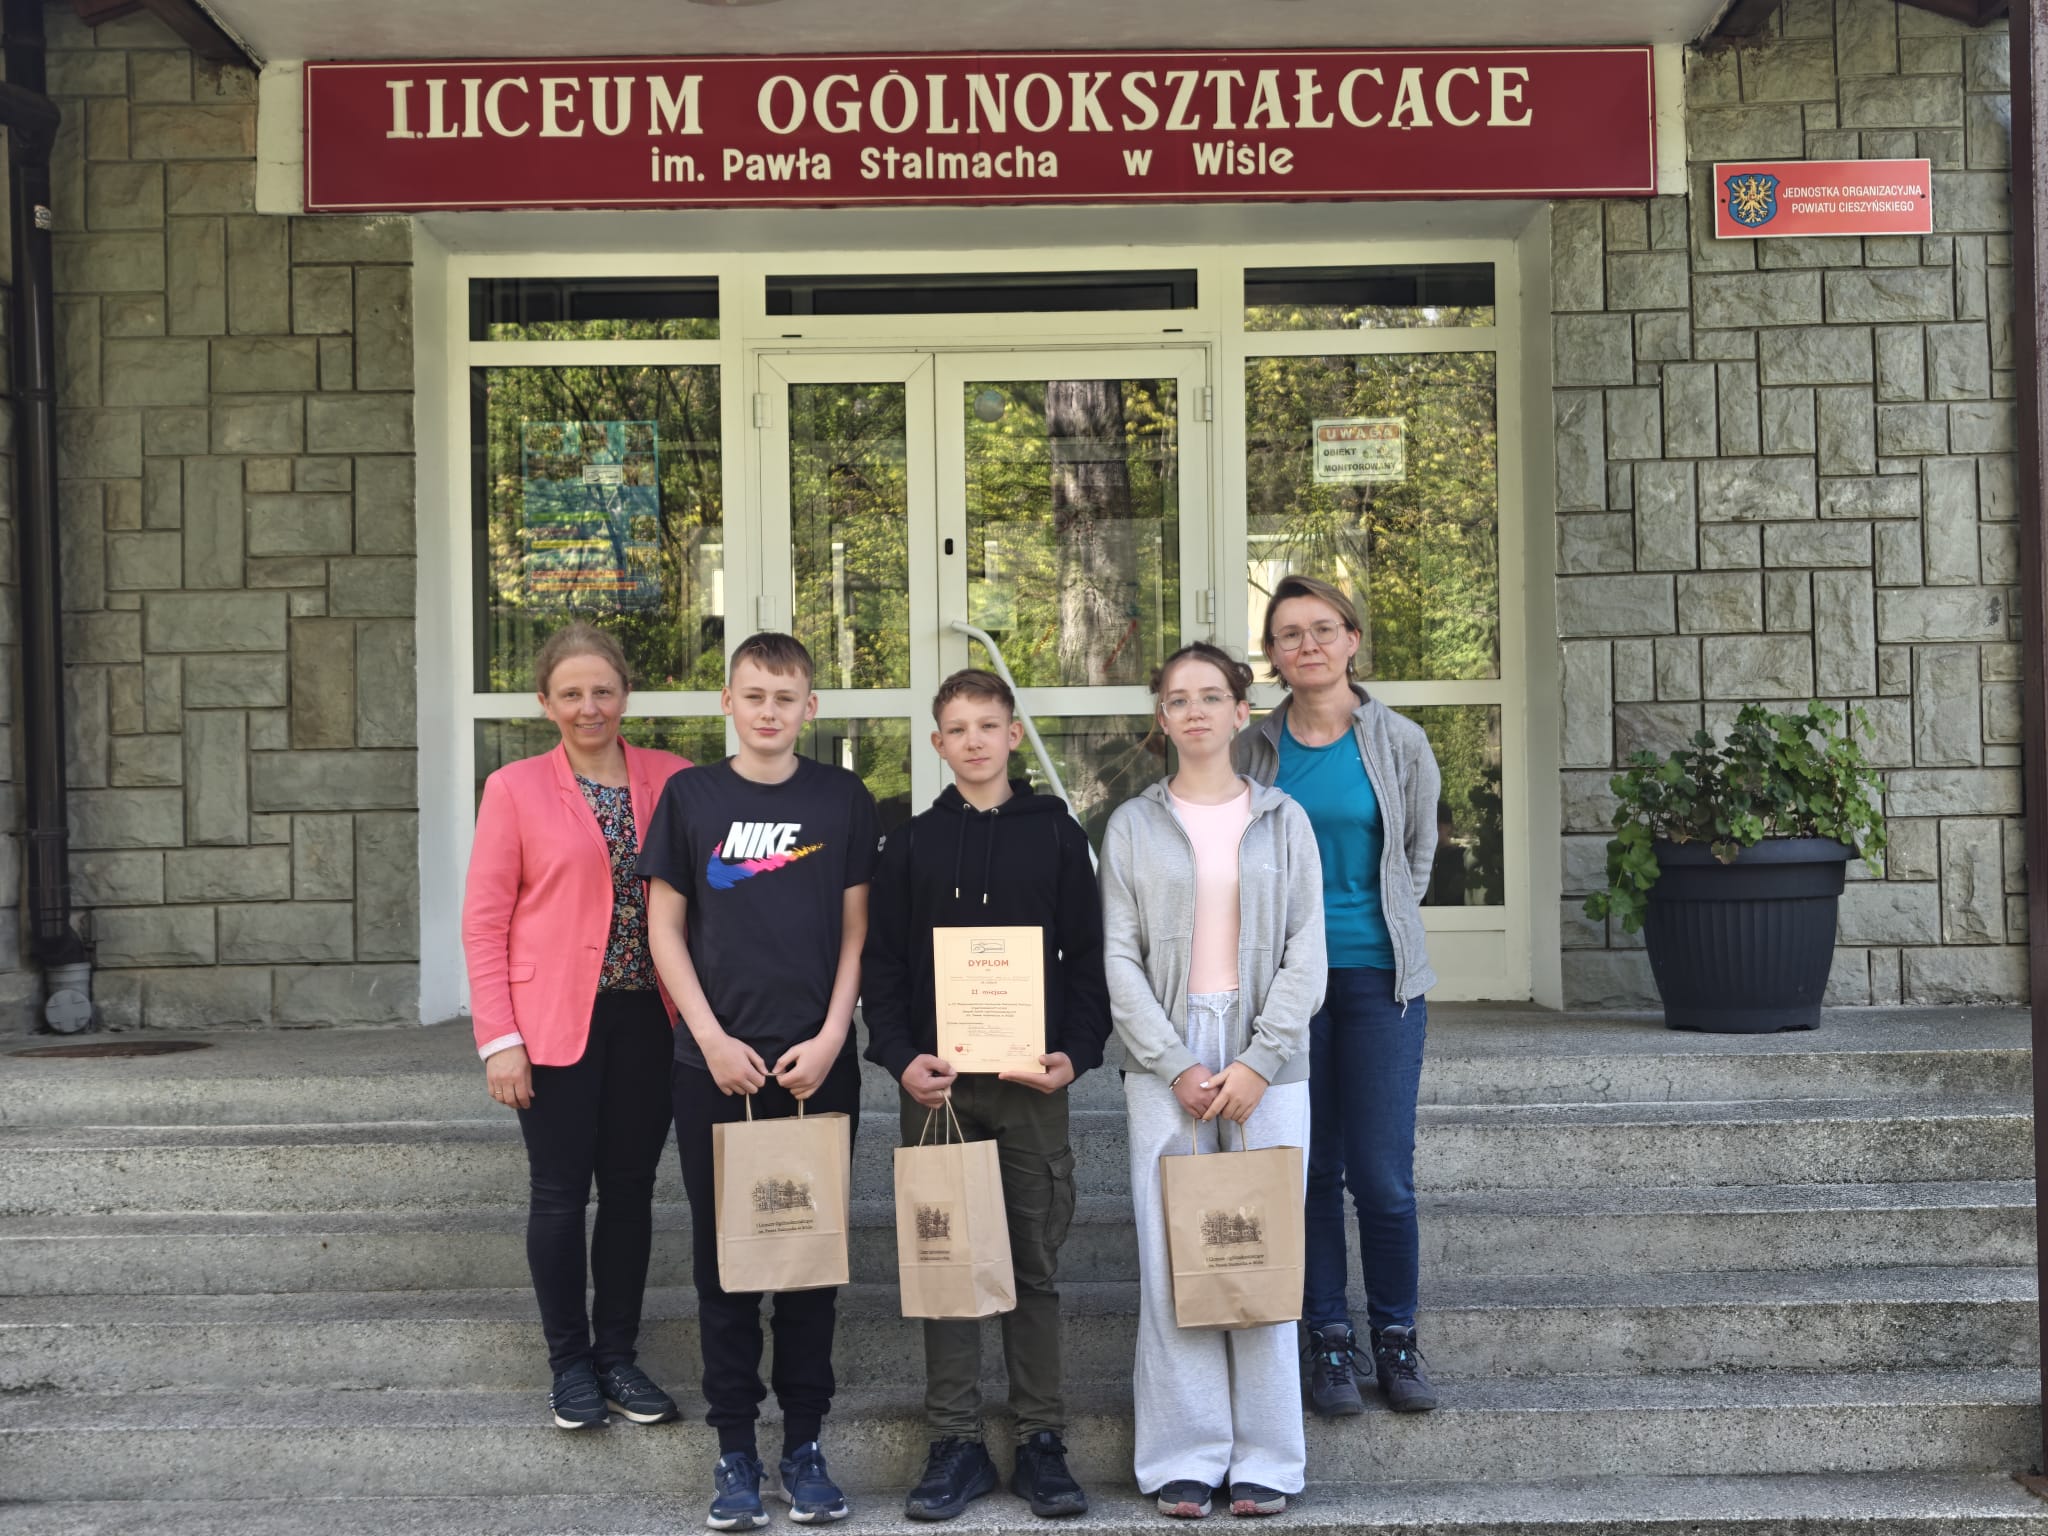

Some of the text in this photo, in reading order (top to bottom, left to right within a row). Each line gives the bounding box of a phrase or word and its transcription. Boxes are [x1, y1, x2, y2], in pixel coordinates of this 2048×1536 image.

[651, 140, 1294, 182] im. Pawła Stalmacha w Wiśle
[1783, 185, 1922, 198] JEDNOSTKA ORGANIZACYJNA
[1792, 199, 1914, 213] POWIATU CIESZYŃSKIEGO
[1326, 427, 1393, 440] UWAGA
[1323, 448, 1356, 457] OBIEKT
[721, 821, 801, 859] NIKE
[968, 959, 1009, 967] DYPLOM
